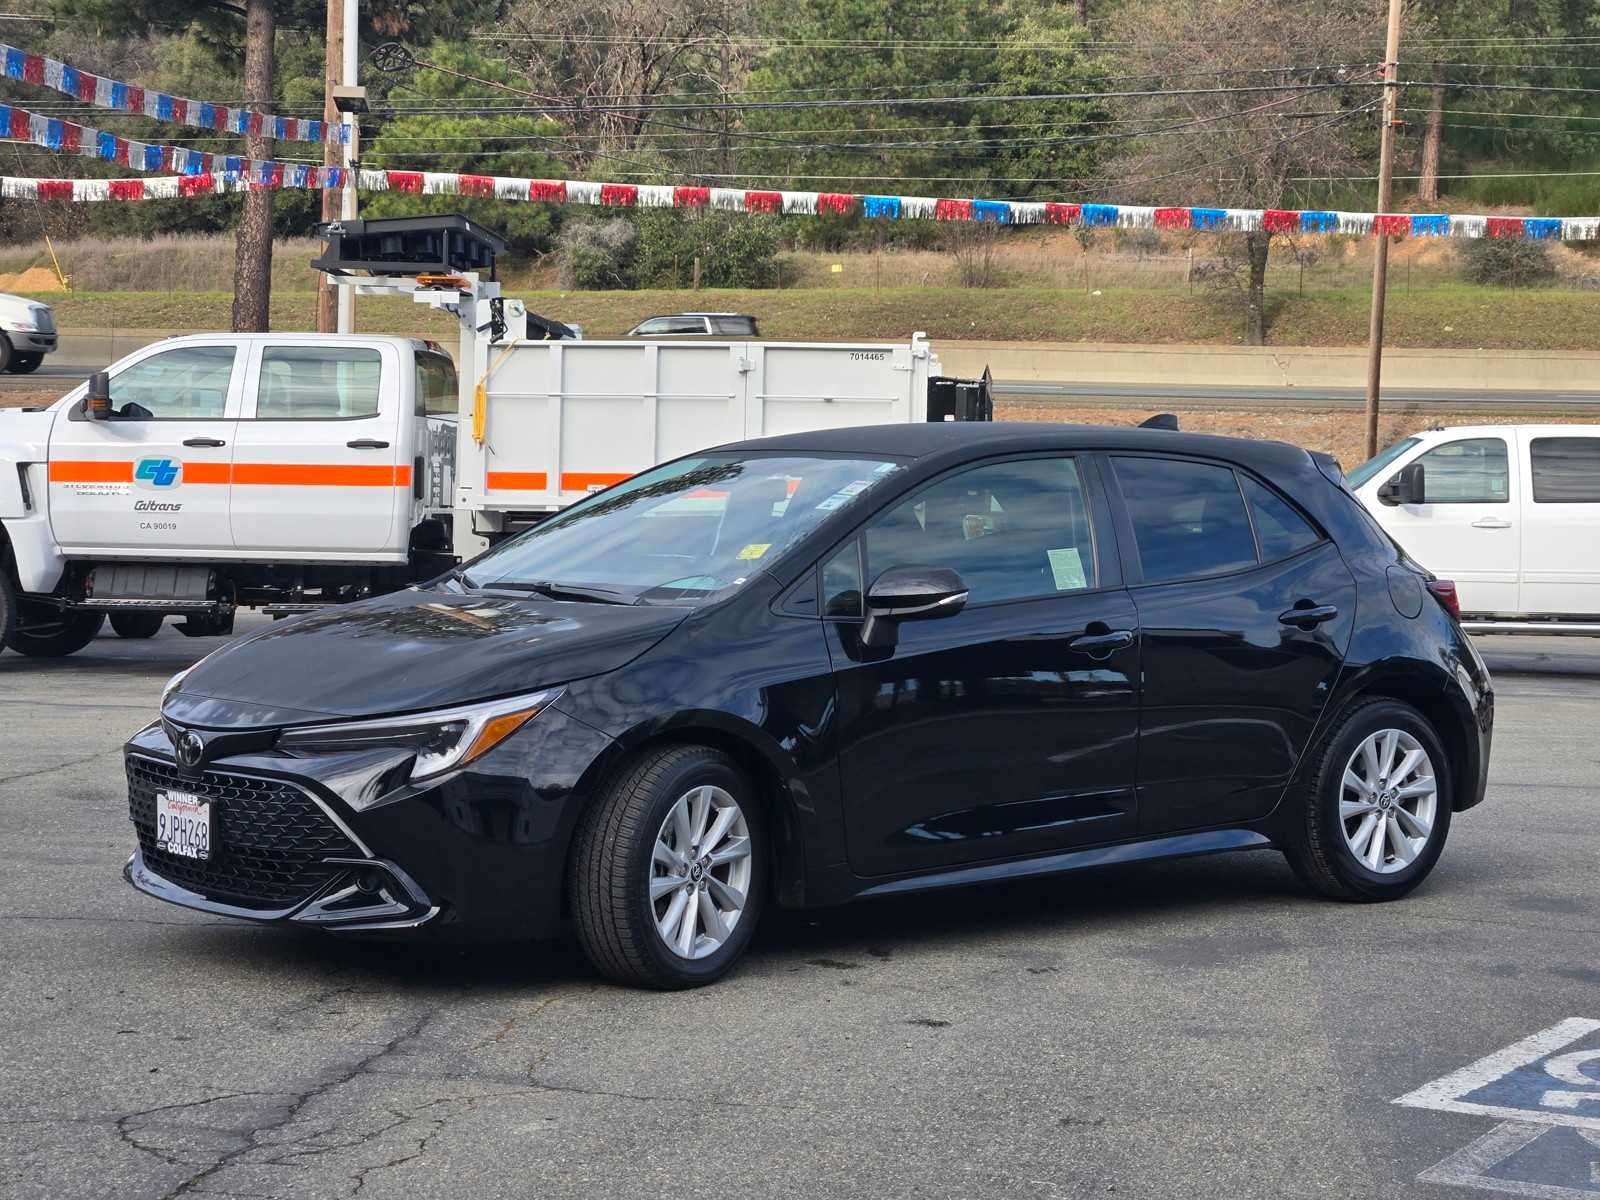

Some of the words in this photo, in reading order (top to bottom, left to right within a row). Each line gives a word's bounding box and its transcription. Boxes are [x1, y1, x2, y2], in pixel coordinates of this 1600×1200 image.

[849, 352, 885, 361] 7014465
[134, 500, 182, 511] Caltrans
[140, 522, 152, 530] CA
[153, 522, 177, 530] 90019
[167, 789, 199, 805] WINNER
[159, 812, 208, 850] 9JPH268
[167, 842, 198, 859] COLFAX
